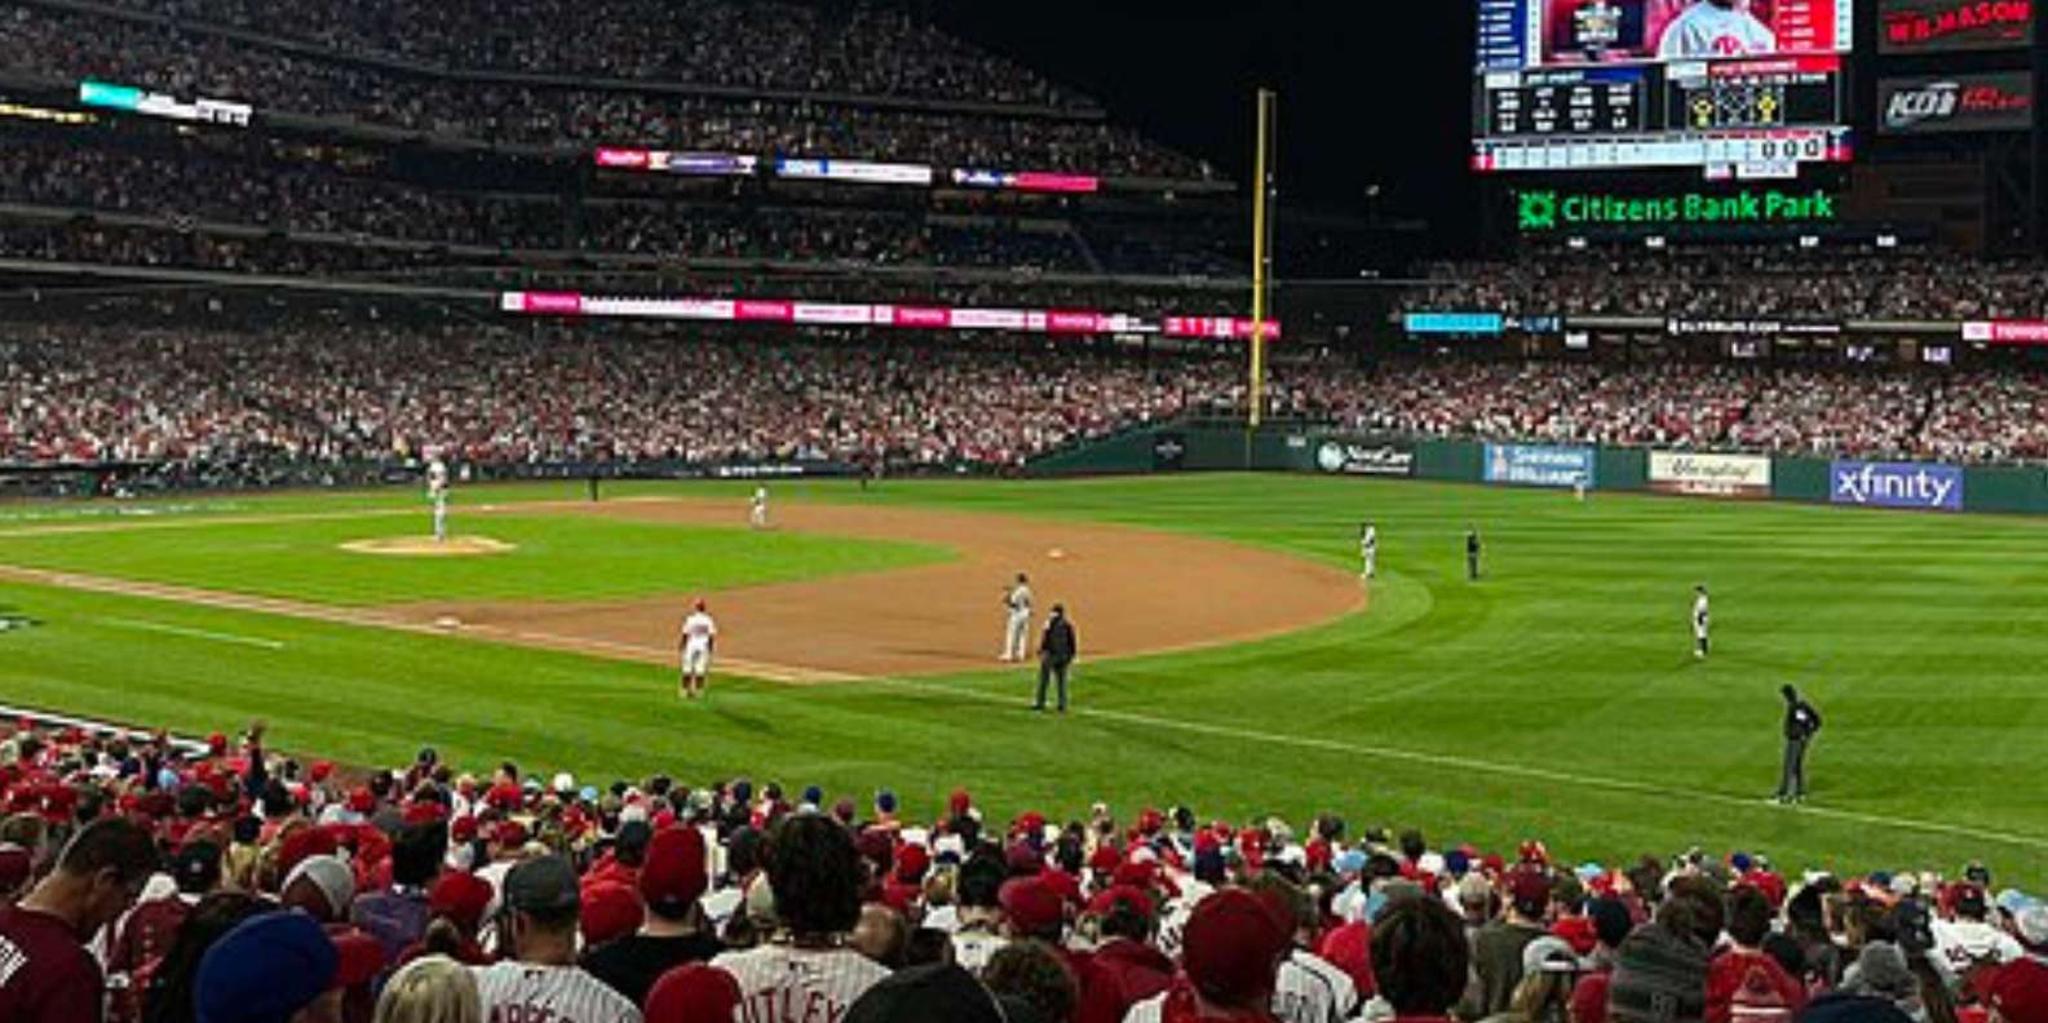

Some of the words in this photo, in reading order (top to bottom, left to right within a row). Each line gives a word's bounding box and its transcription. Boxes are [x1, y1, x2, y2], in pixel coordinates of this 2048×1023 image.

[1562, 192, 1679, 224] Citizens
[1685, 191, 1760, 220] Bank
[1766, 189, 1834, 217] Park
[1838, 463, 1956, 509] xfinity
